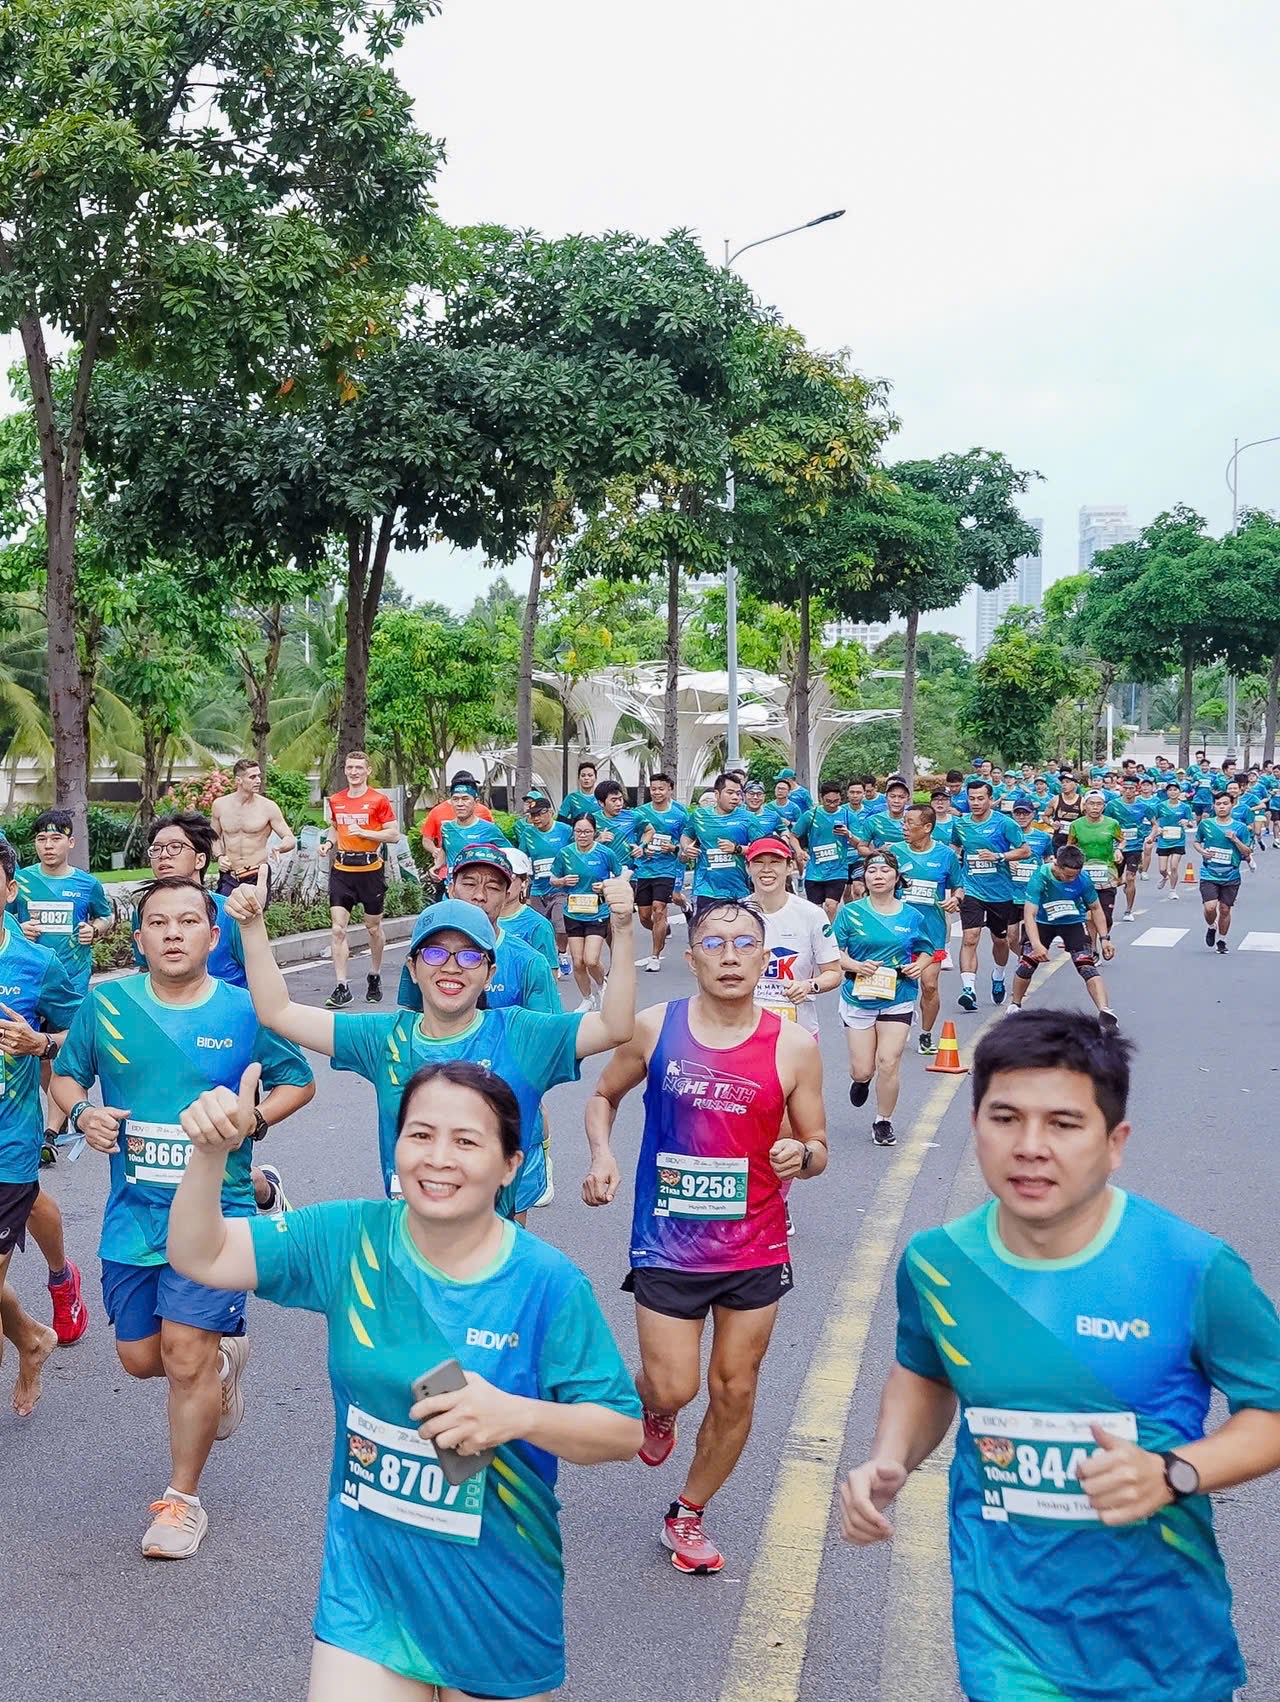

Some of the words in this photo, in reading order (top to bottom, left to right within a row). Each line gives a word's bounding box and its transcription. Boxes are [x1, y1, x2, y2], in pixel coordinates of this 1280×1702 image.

[40, 911, 68, 924] 8037
[764, 956, 798, 980] GK
[197, 1036, 224, 1050] BIDV
[693, 1097, 748, 1116] RUNNERS
[681, 1174, 737, 1198] 9258
[657, 1198, 668, 1208] M
[465, 1327, 509, 1351] BIDV
[1076, 1315, 1130, 1342] BIDV
[348, 1460, 376, 1484] 10KM
[983, 1465, 1019, 1486] 10KM
[1016, 1444, 1106, 1489] 844
[344, 1479, 357, 1498] M
[984, 1489, 1002, 1507] M
